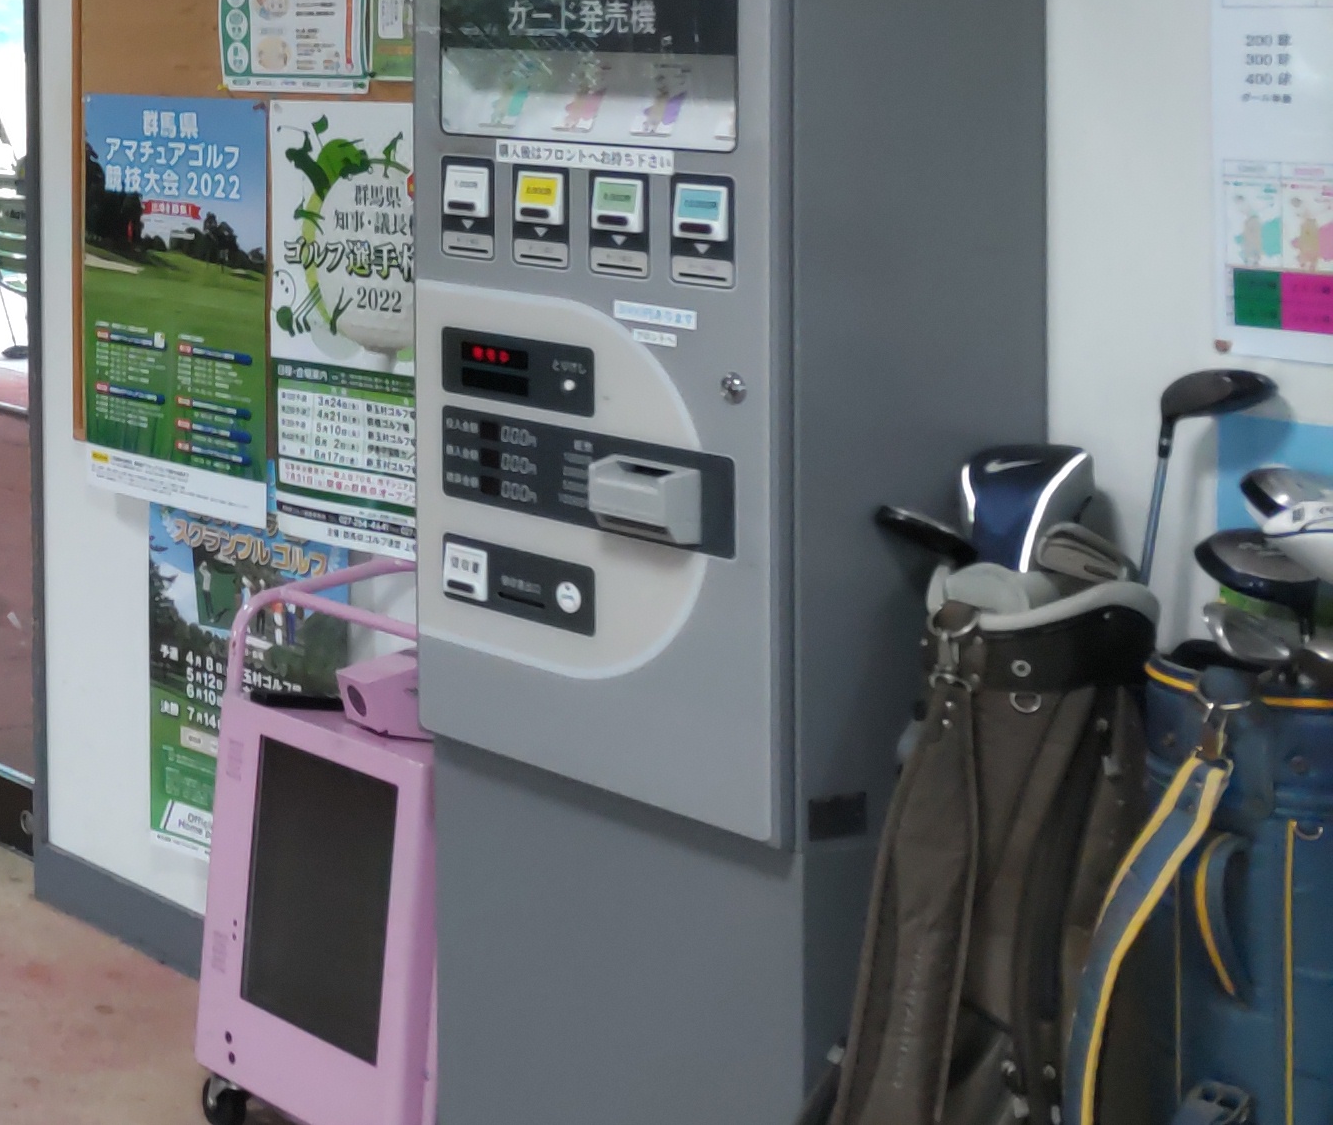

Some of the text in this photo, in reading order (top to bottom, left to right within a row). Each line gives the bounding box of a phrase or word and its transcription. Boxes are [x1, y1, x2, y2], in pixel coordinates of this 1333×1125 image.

[508, 0, 657, 35] カード発売機
[142, 109, 199, 139] 群馬県
[105, 137, 240, 171] アマチュアゴルフ
[498, 143, 672, 169] 購入後はフロントへお持ち下さい
[104, 164, 241, 200] 競技大会 2022
[354, 184, 402, 208] 群馬県
[334, 210, 414, 237] 知事・議長
[356, 286, 403, 314] 2022
[173, 517, 328, 577] スクランブル ゴルフ
